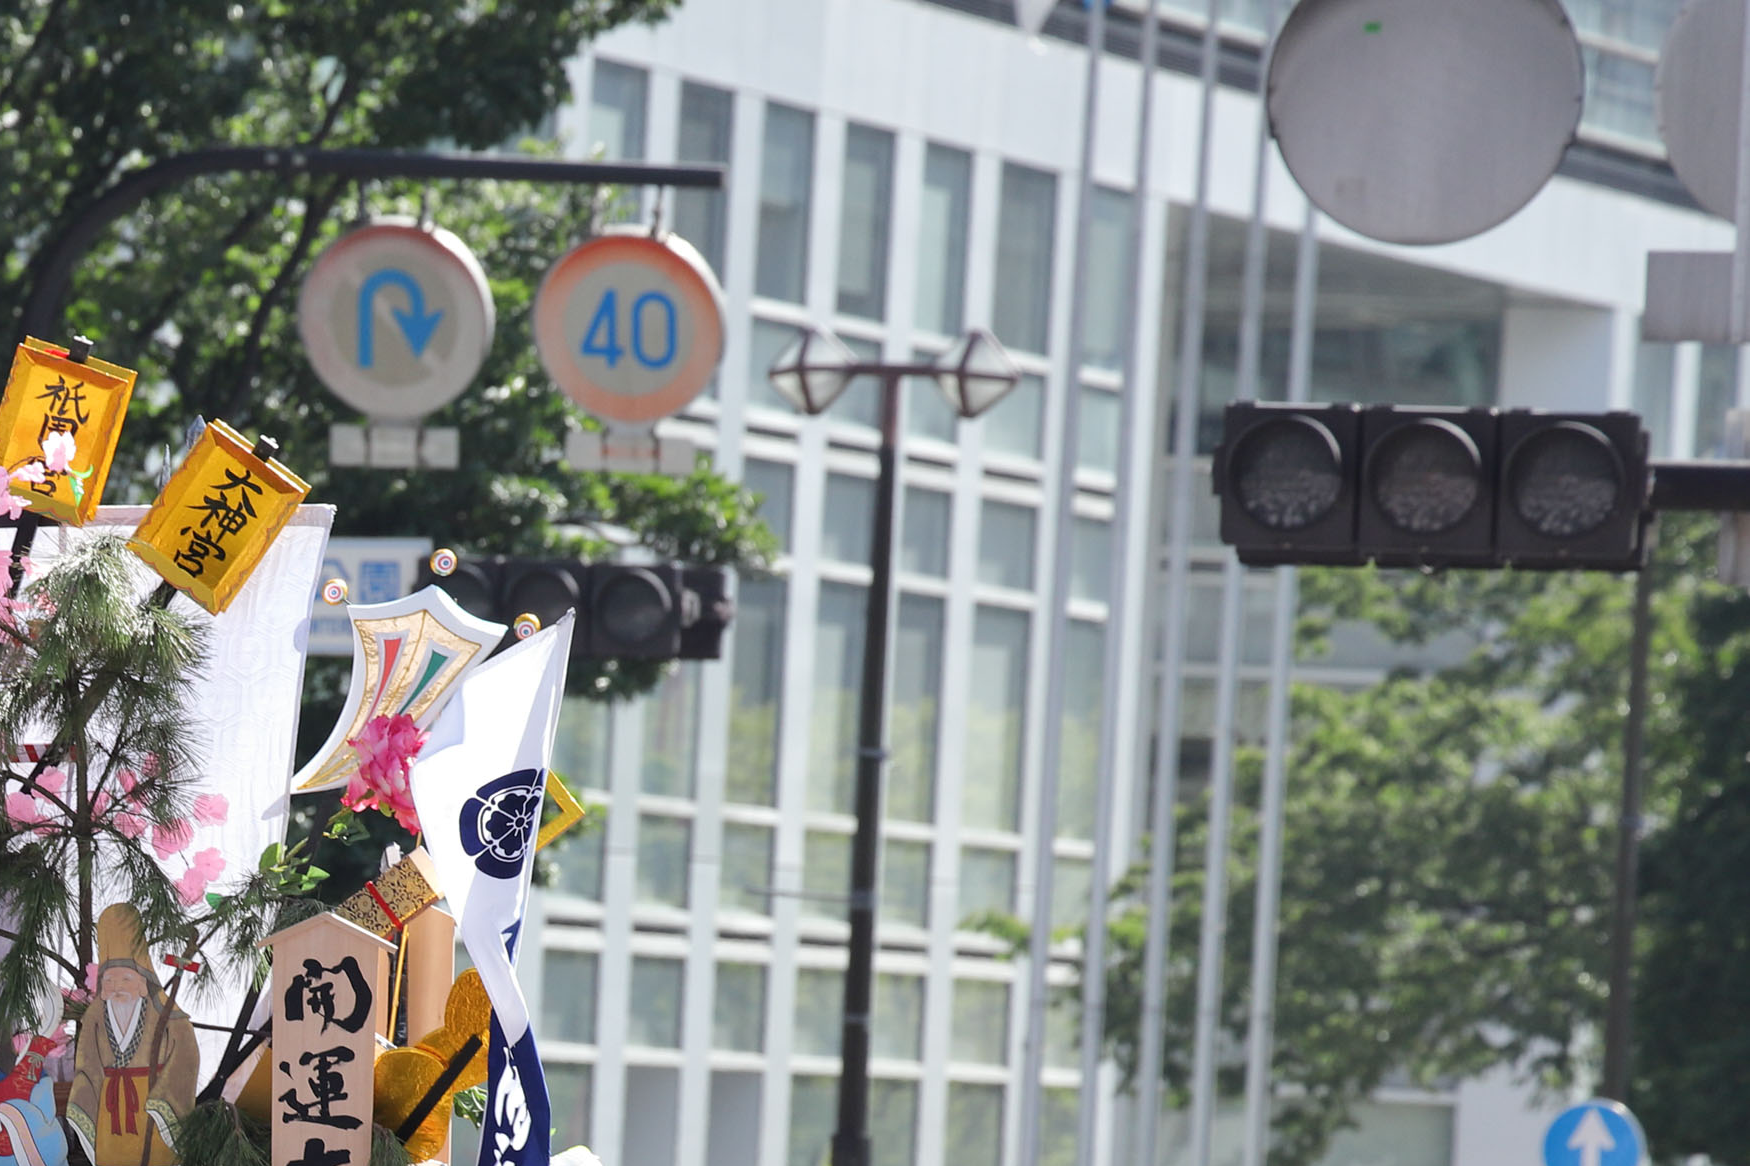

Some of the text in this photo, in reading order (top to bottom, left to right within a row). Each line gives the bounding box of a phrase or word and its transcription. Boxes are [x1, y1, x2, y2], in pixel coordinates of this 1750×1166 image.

[581, 289, 678, 370] 40
[174, 468, 264, 579] 大神宮
